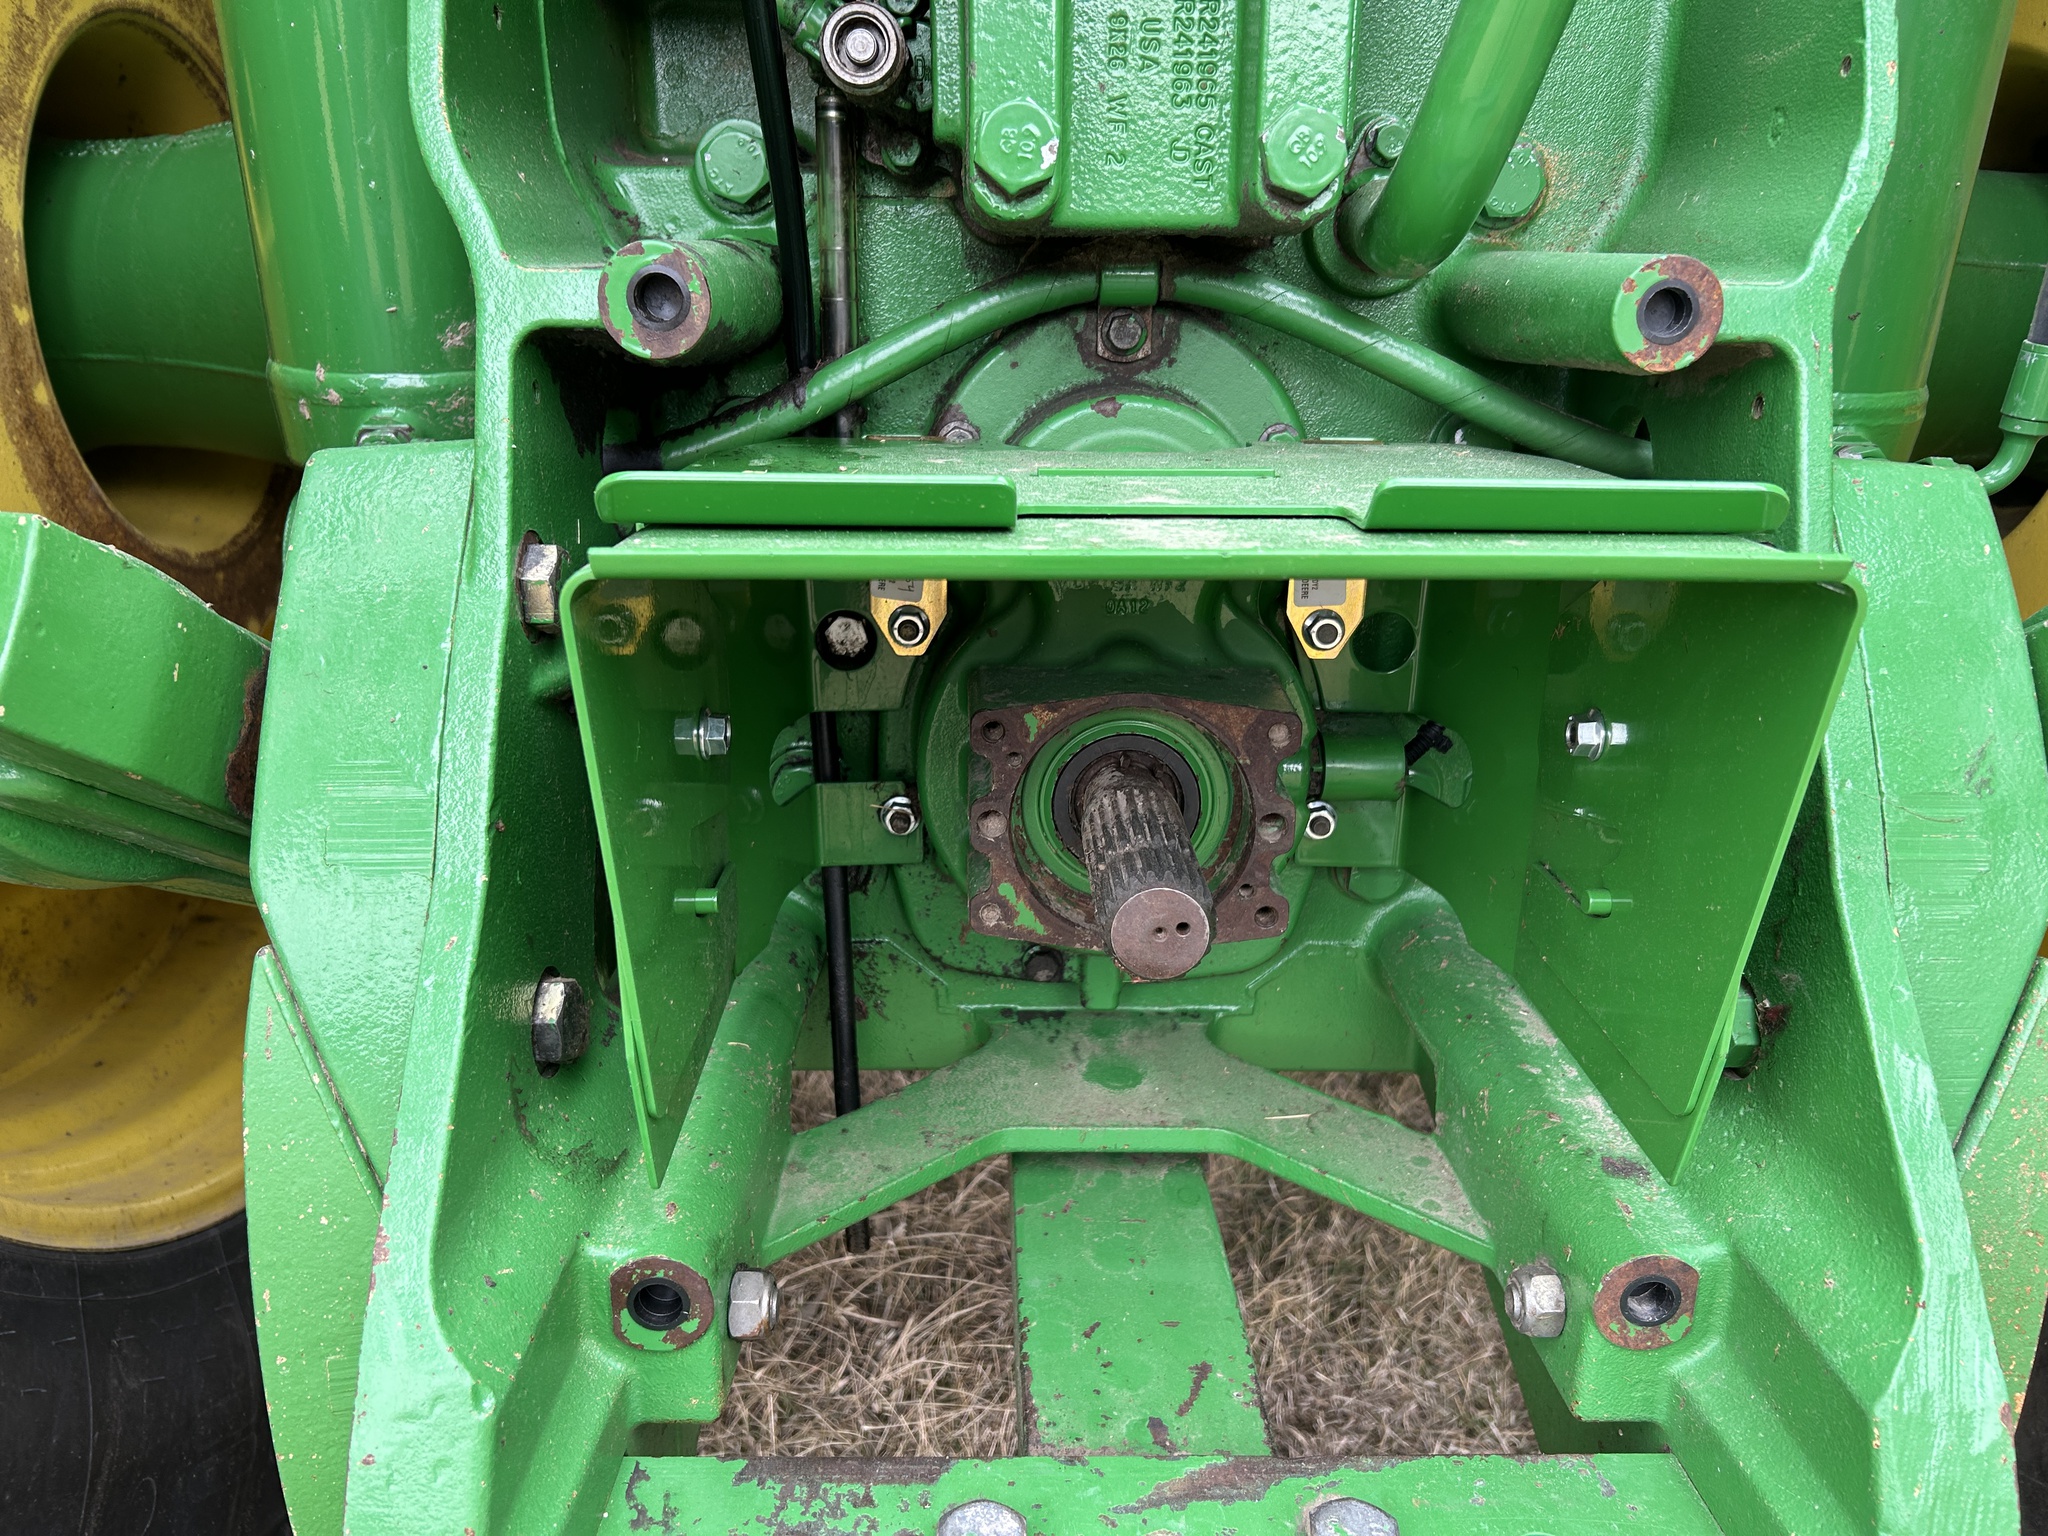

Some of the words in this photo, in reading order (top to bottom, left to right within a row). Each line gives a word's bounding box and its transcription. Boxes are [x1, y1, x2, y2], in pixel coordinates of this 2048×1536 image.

[1139, 17, 1161, 73] USA
[1171, 0, 1194, 109] R241963
[1197, 0, 1219, 110] R241965
[1106, 152, 1127, 169] 2
[1194, 123, 1215, 191] CAST
